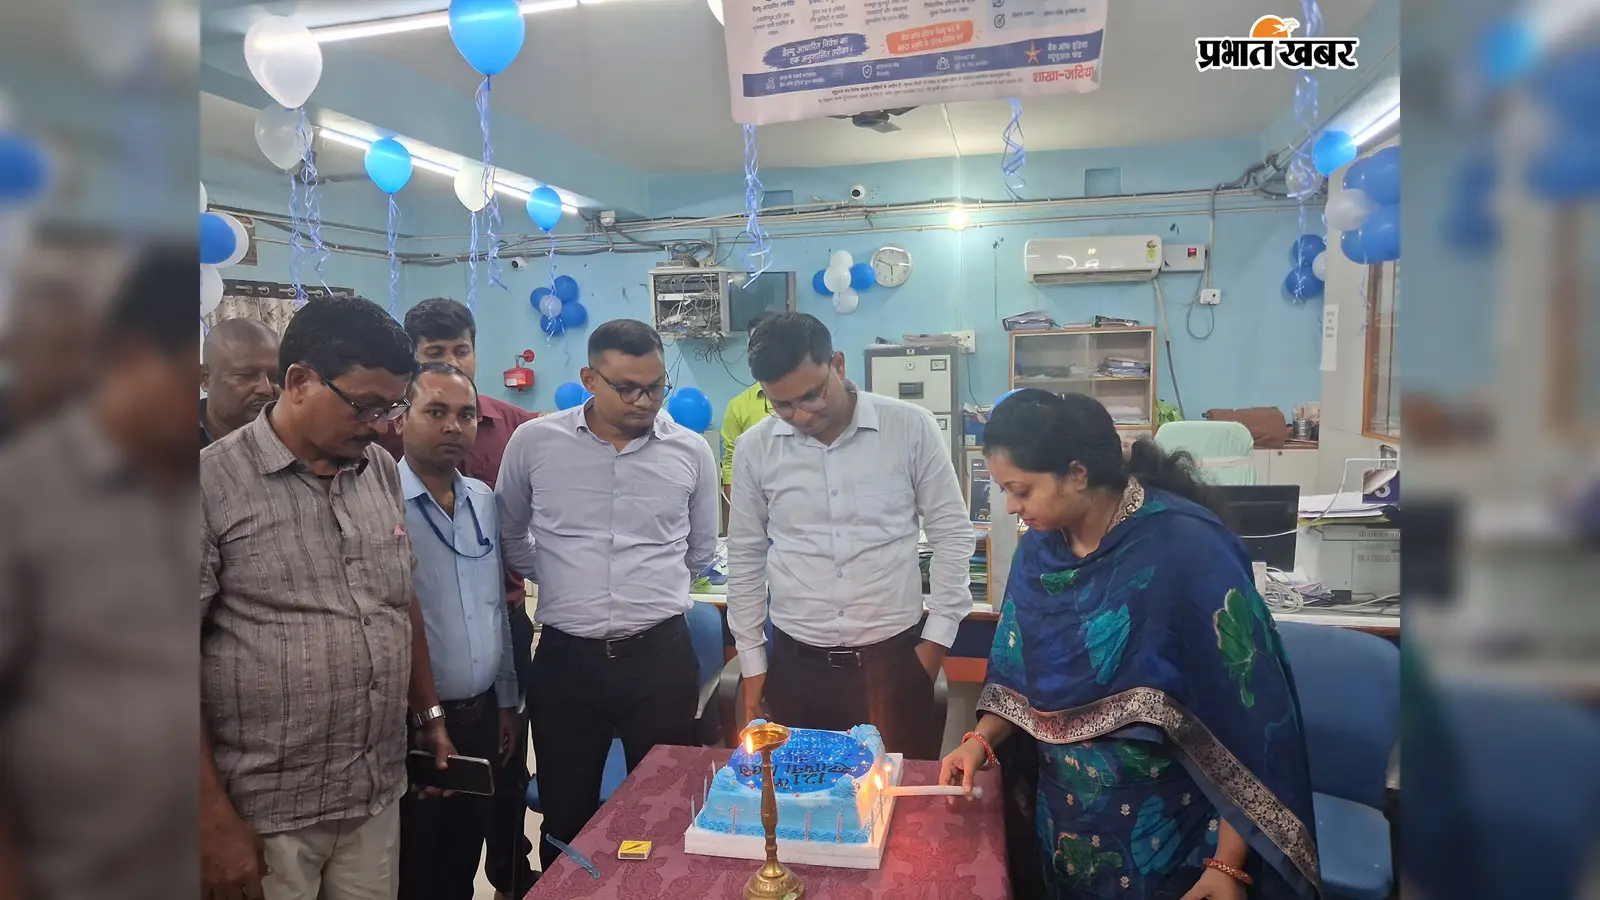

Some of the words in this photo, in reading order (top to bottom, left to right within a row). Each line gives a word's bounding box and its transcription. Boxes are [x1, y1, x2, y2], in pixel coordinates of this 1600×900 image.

[782, 47, 796, 57] वैल्यू
[797, 41, 821, 53] आधारित
[822, 37, 839, 49] निवेश
[840, 36, 848, 44] का
[789, 56, 799, 65] एक
[801, 49, 831, 64] अनुशासित
[1033, 64, 1095, 83] शाखा-जदिया
[793, 772, 826, 786] 121
